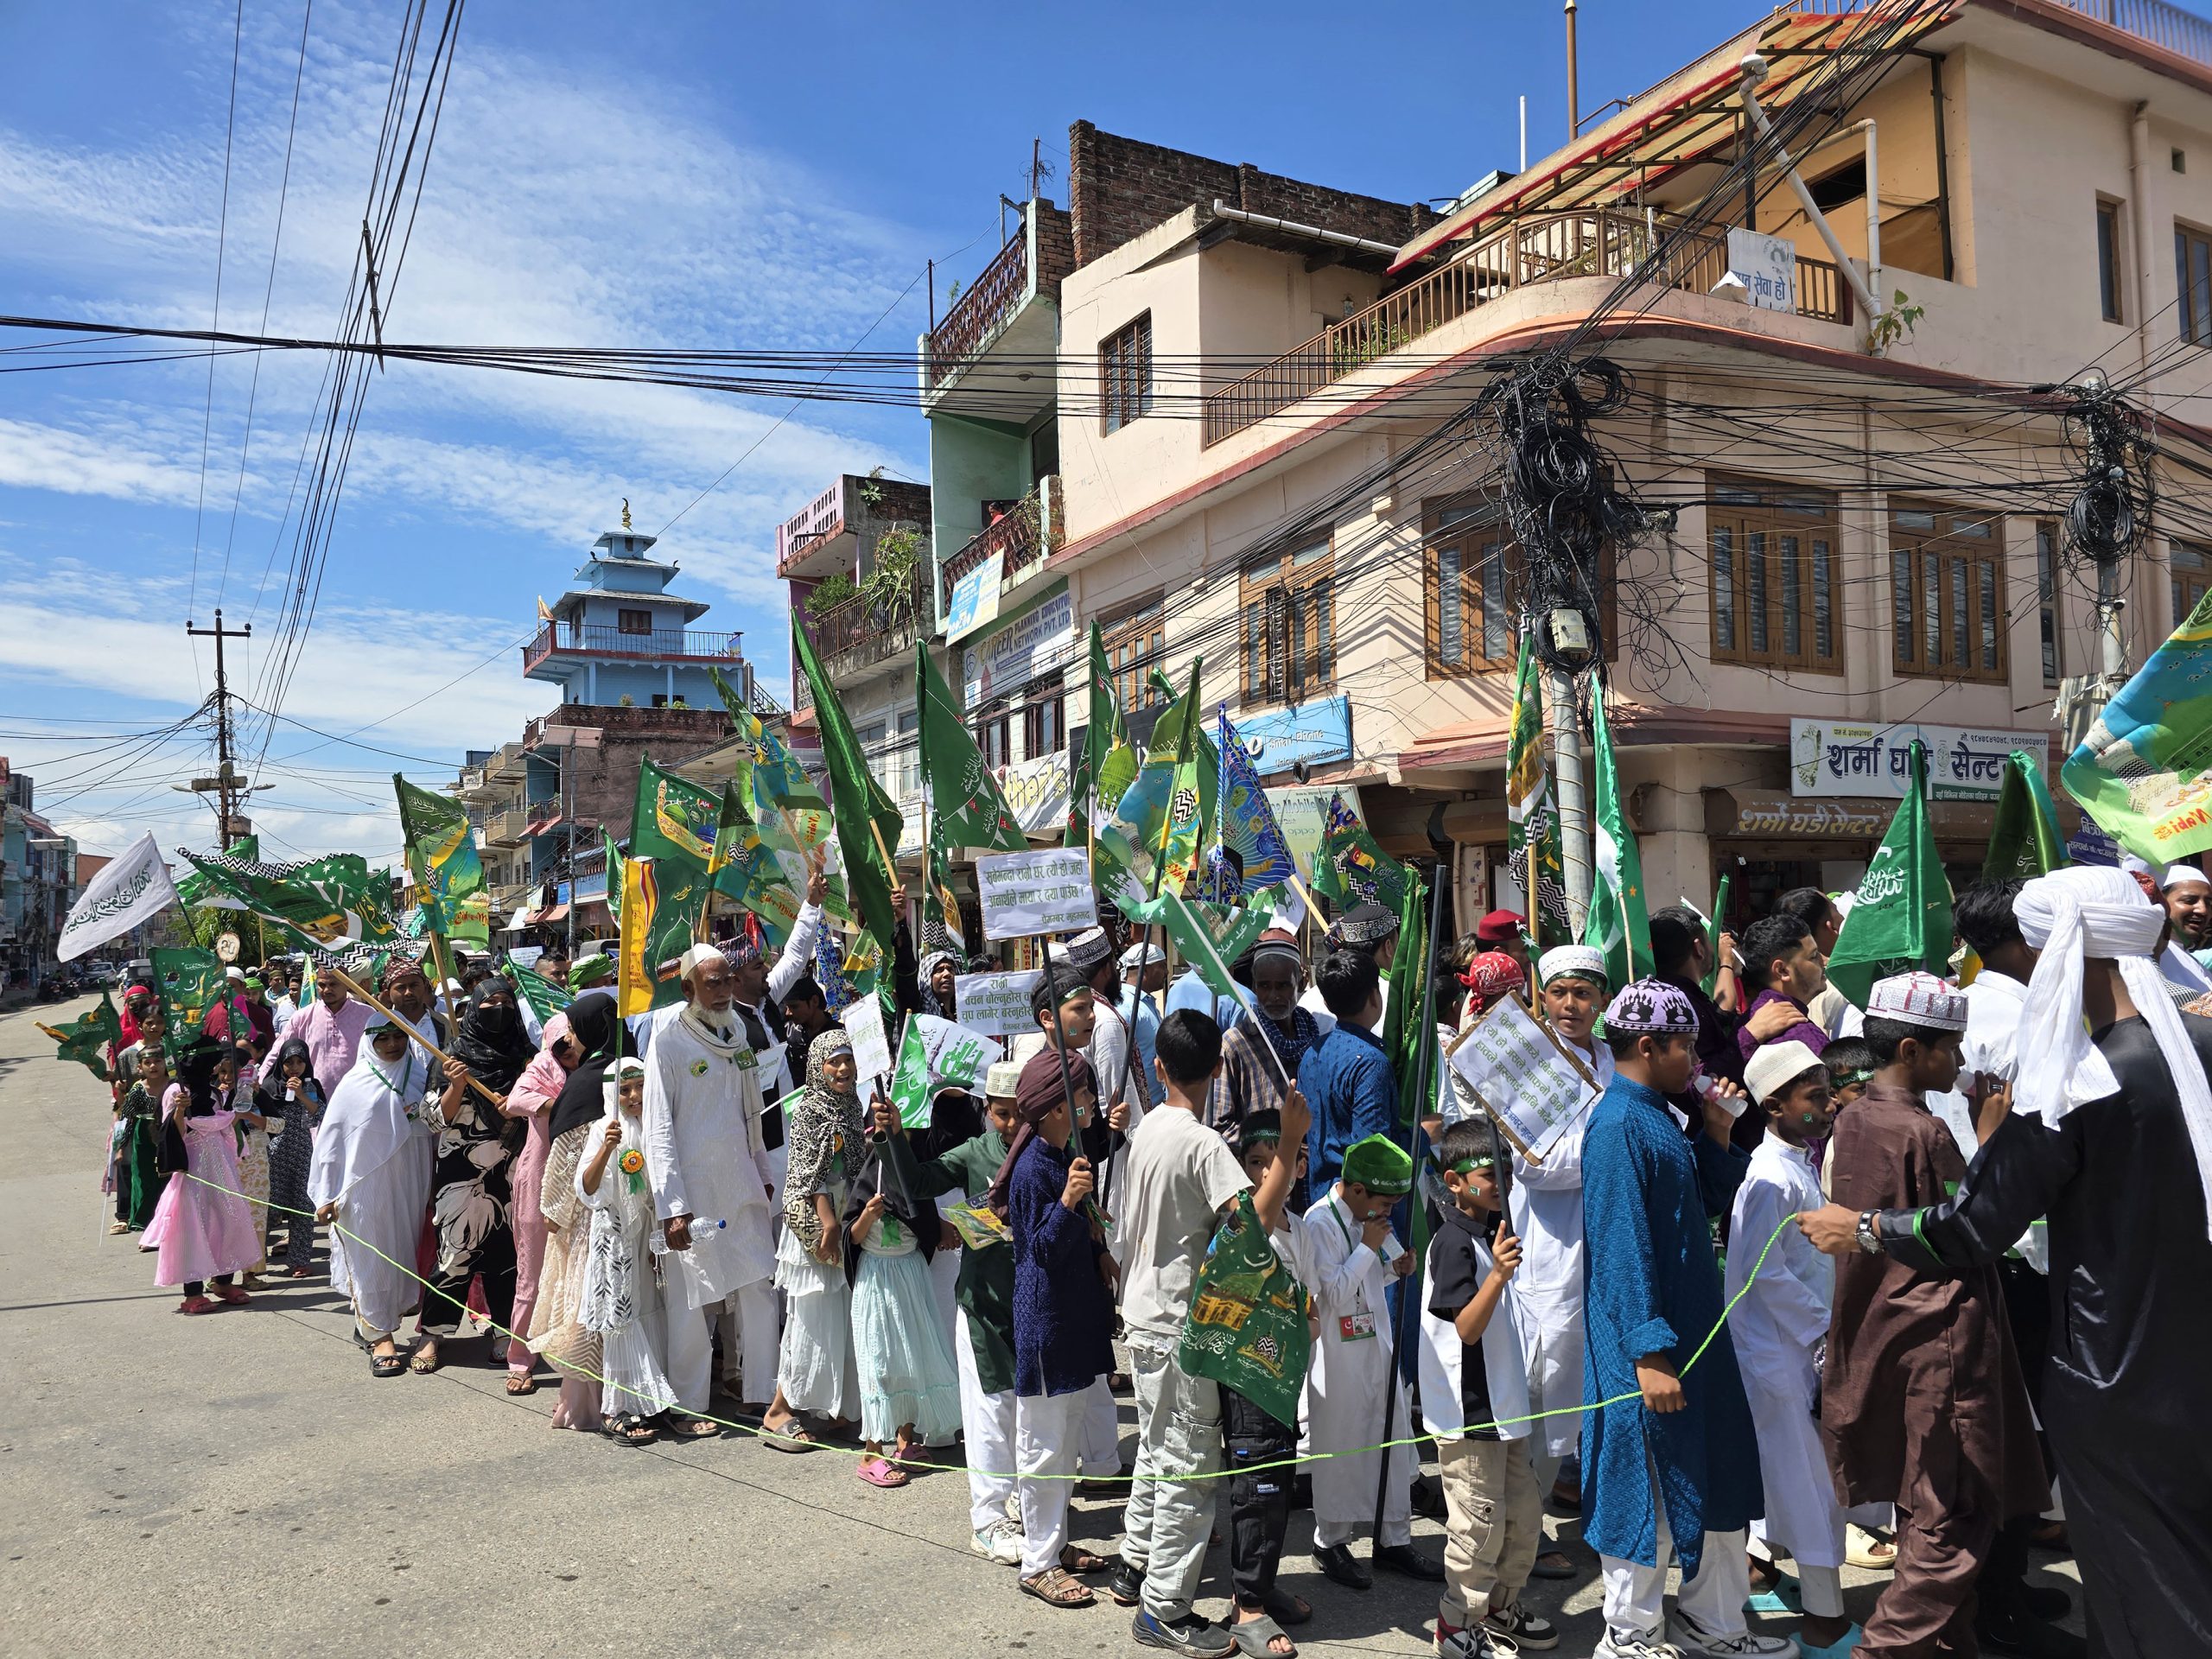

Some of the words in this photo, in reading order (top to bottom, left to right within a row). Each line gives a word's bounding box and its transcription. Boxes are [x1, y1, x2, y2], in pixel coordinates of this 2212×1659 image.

[1014, 626, 1043, 652] NETWORK
[1296, 729, 1325, 742] Phone
[1827, 737, 1884, 778] शर्मा
[1950, 741, 2012, 781] सेन्ट
[1033, 866, 1046, 879] घर
[1046, 861, 1058, 878] त्यो
[1059, 859, 1068, 877] हो
[1019, 890, 1035, 904] माया
[1037, 890, 1042, 903] र
[1483, 1022, 1499, 1039] त्यो
[1496, 1038, 1507, 1049] हो
[1505, 1046, 1527, 1071] जसले
